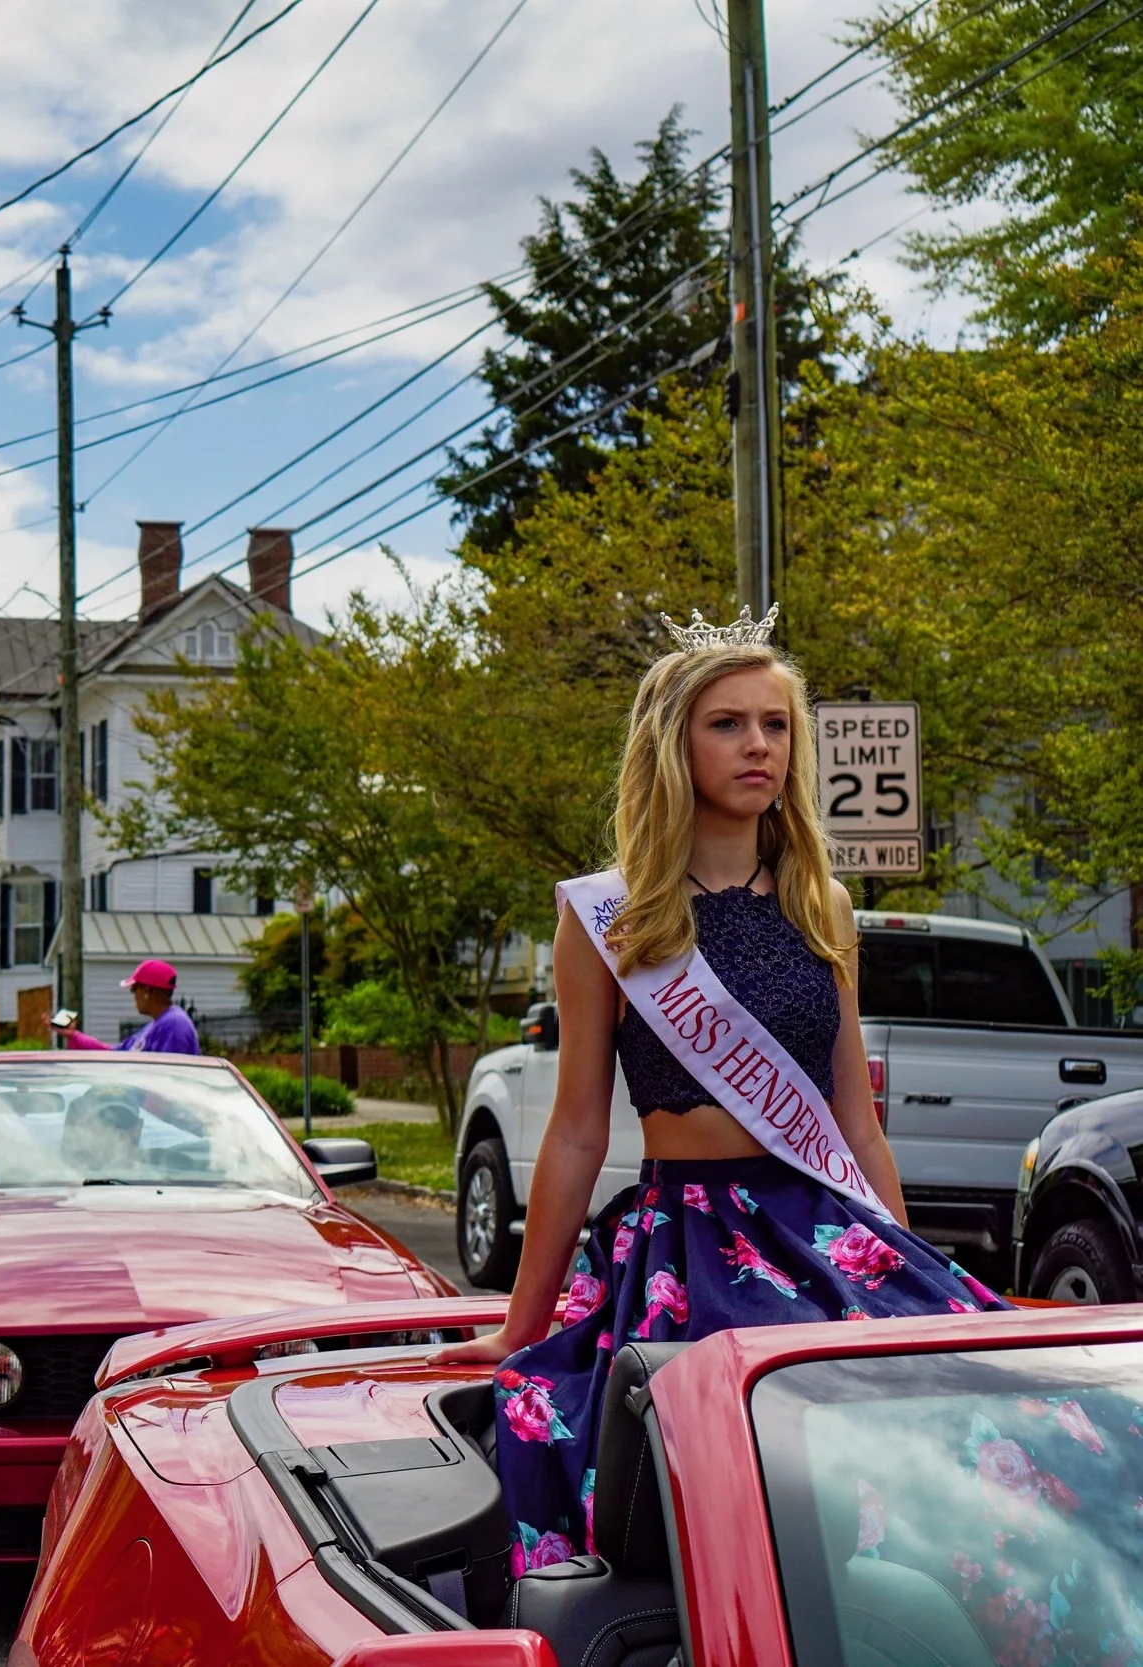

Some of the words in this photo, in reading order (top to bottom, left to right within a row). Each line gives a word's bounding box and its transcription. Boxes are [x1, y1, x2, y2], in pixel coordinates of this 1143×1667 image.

[825, 719, 909, 739] SPEED
[833, 746, 901, 766] LIMIT
[828, 772, 909, 817] 25
[875, 847, 917, 866] WIDE
[650, 970, 732, 1054] MISS
[712, 1037, 870, 1198] HENDERSON
